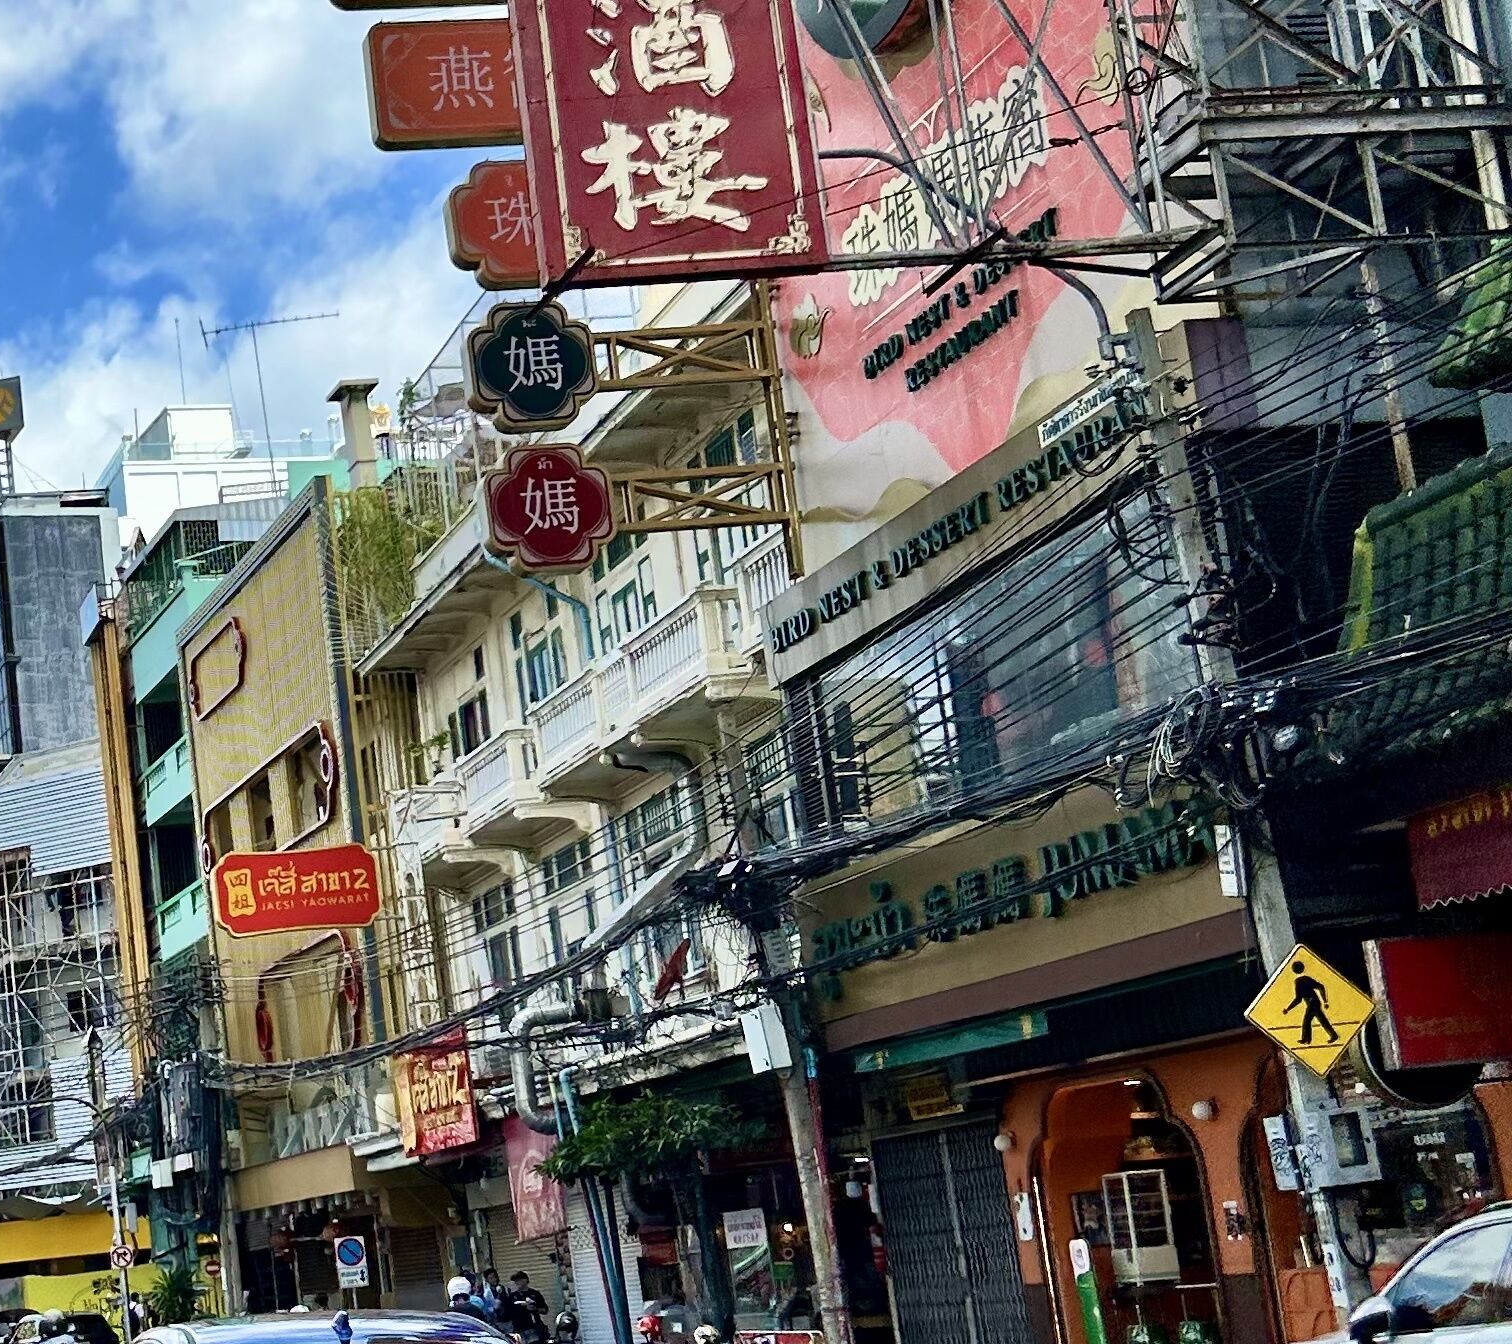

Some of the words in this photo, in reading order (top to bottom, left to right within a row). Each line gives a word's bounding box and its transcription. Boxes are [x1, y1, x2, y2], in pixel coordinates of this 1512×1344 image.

[503, 334, 563, 393] 媽
[520, 476, 580, 535] 媽
[769, 608, 815, 654] BIRD
[817, 570, 869, 624] NEST
[871, 560, 892, 590] &
[890, 492, 990, 578] DESSERT
[300, 892, 371, 909] YAOWARAT
